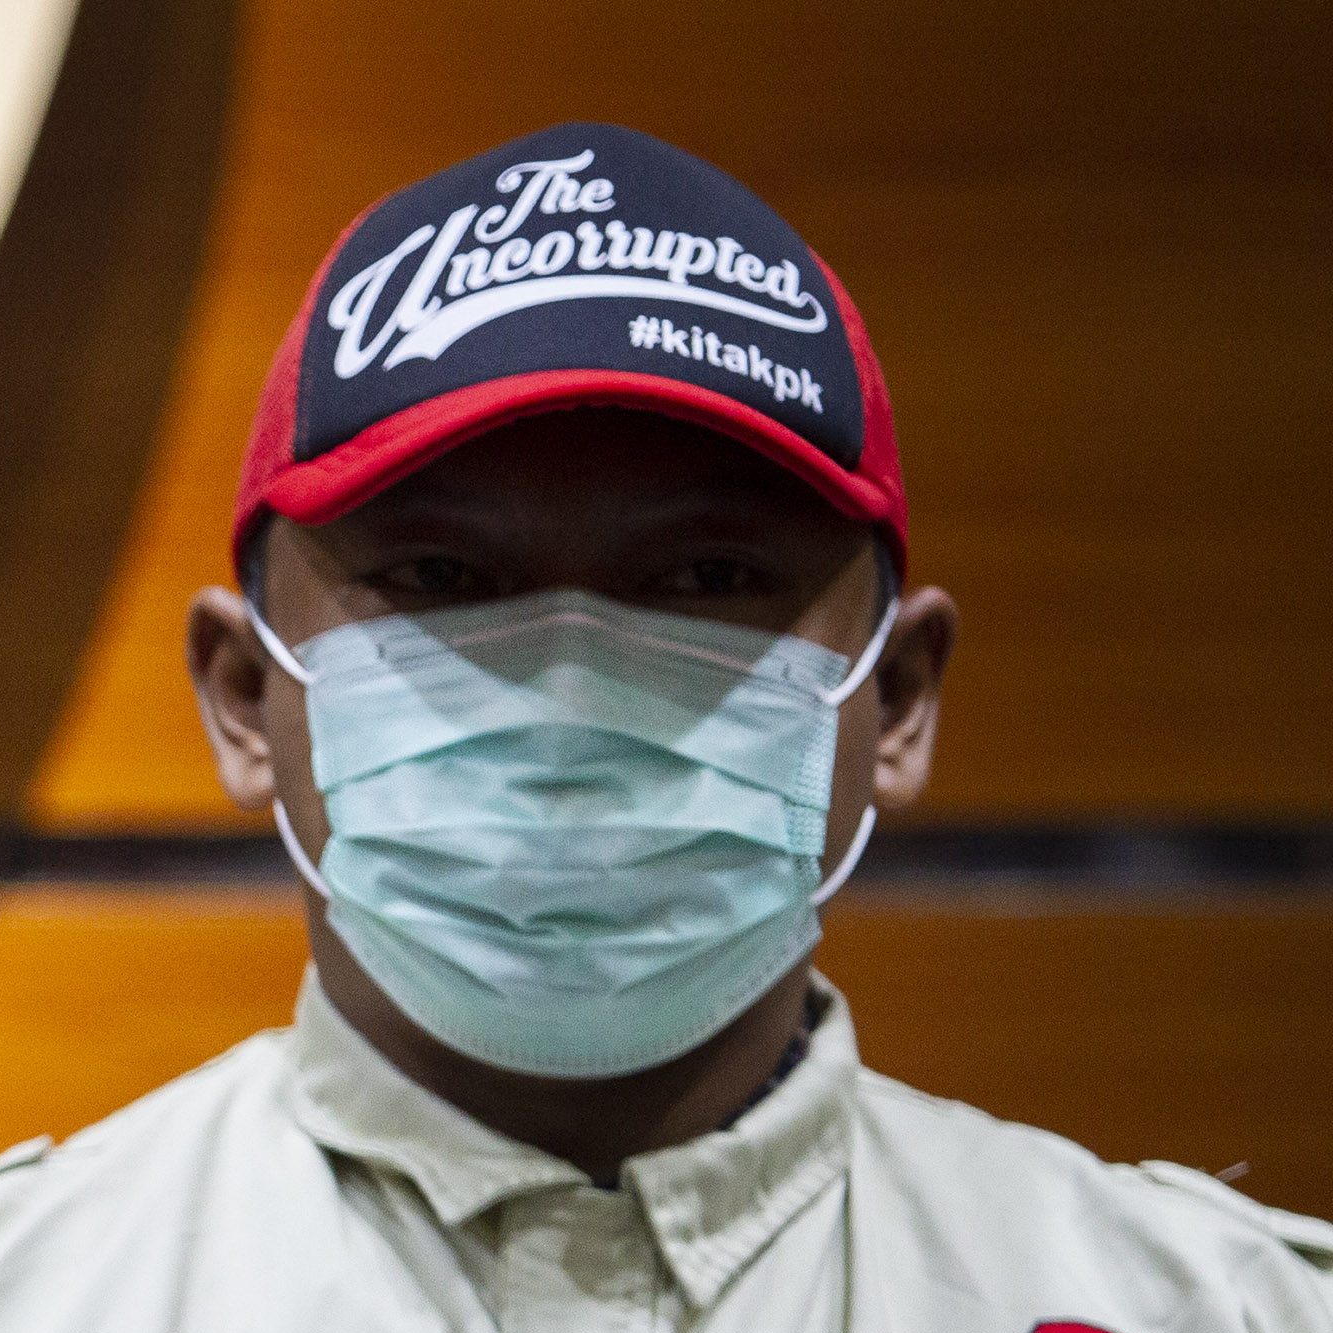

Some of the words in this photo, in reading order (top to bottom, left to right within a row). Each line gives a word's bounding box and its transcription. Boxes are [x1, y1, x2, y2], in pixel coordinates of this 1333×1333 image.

[475, 149, 615, 243] The
[328, 204, 823, 379] Uncorrupted
[628, 314, 825, 414] #kitakpk
